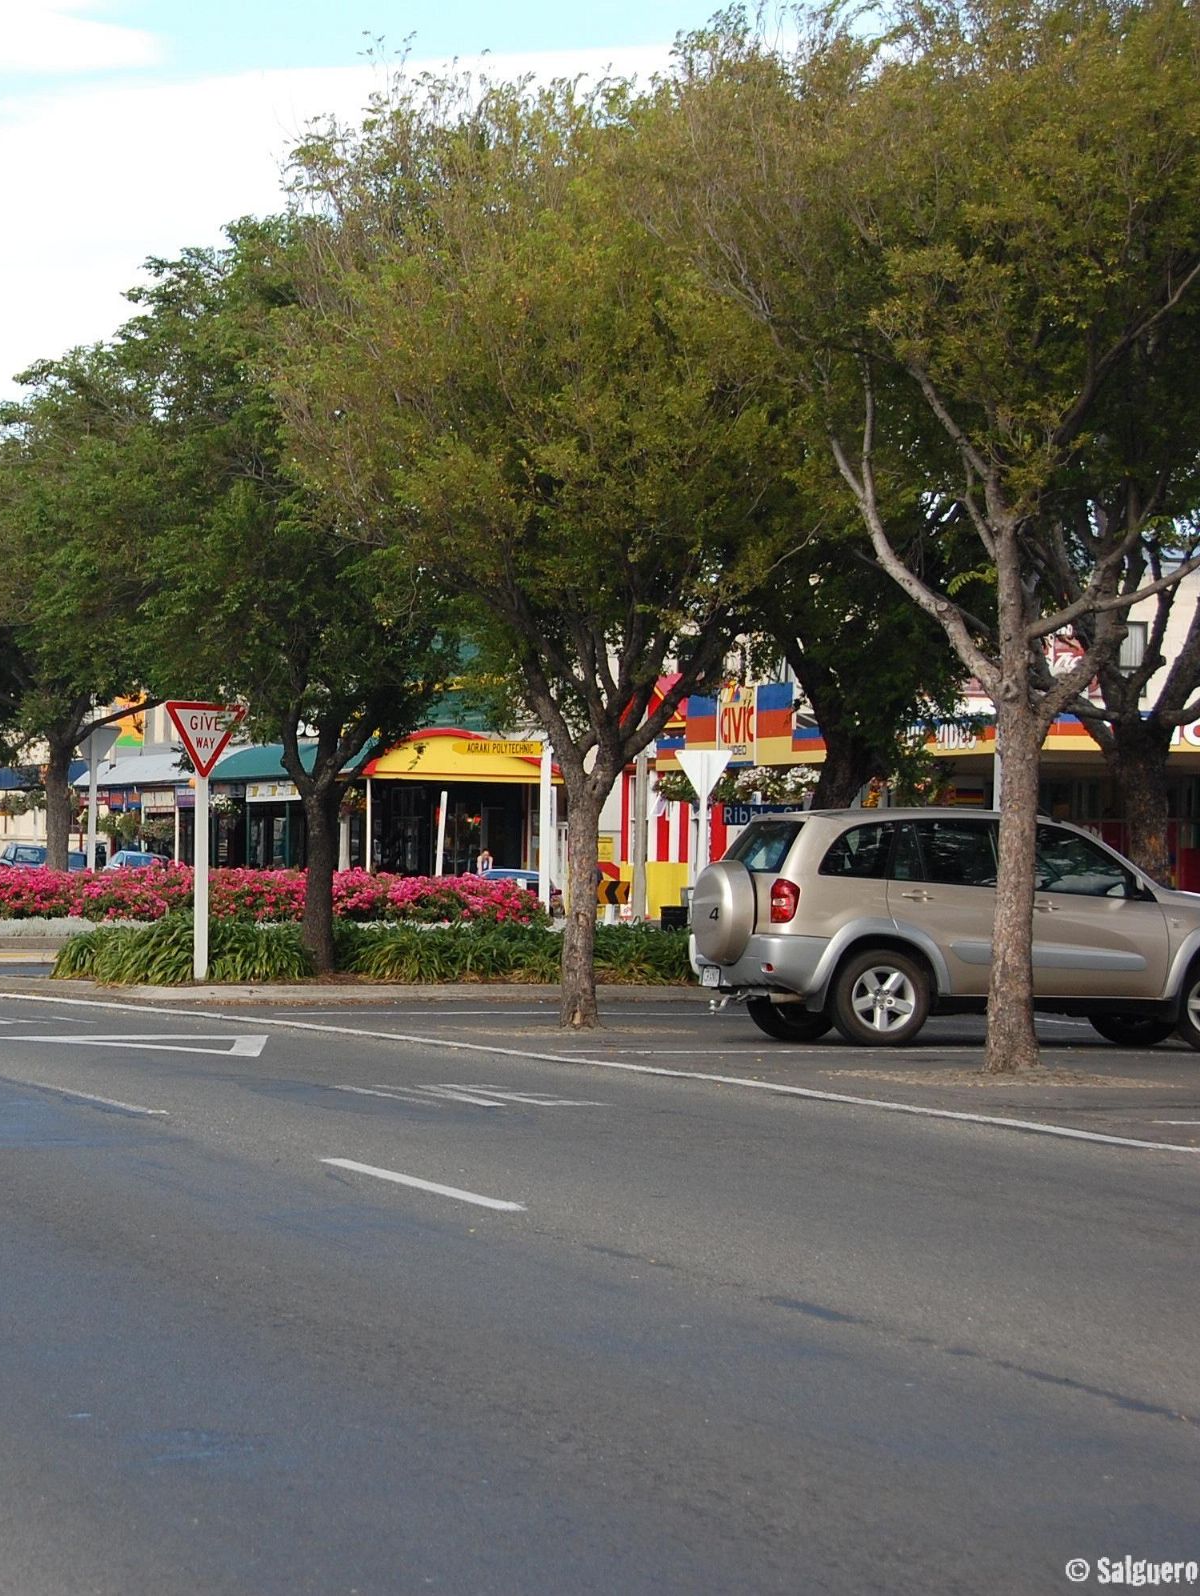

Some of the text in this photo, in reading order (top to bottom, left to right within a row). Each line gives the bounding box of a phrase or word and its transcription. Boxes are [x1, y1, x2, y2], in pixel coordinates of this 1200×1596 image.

[190, 715, 221, 732] GIVE
[721, 706, 754, 743] CIVIC
[196, 737, 215, 749] WAY
[467, 743, 534, 754] AORAKI POLYTECHNIC
[708, 906, 720, 921] 4
